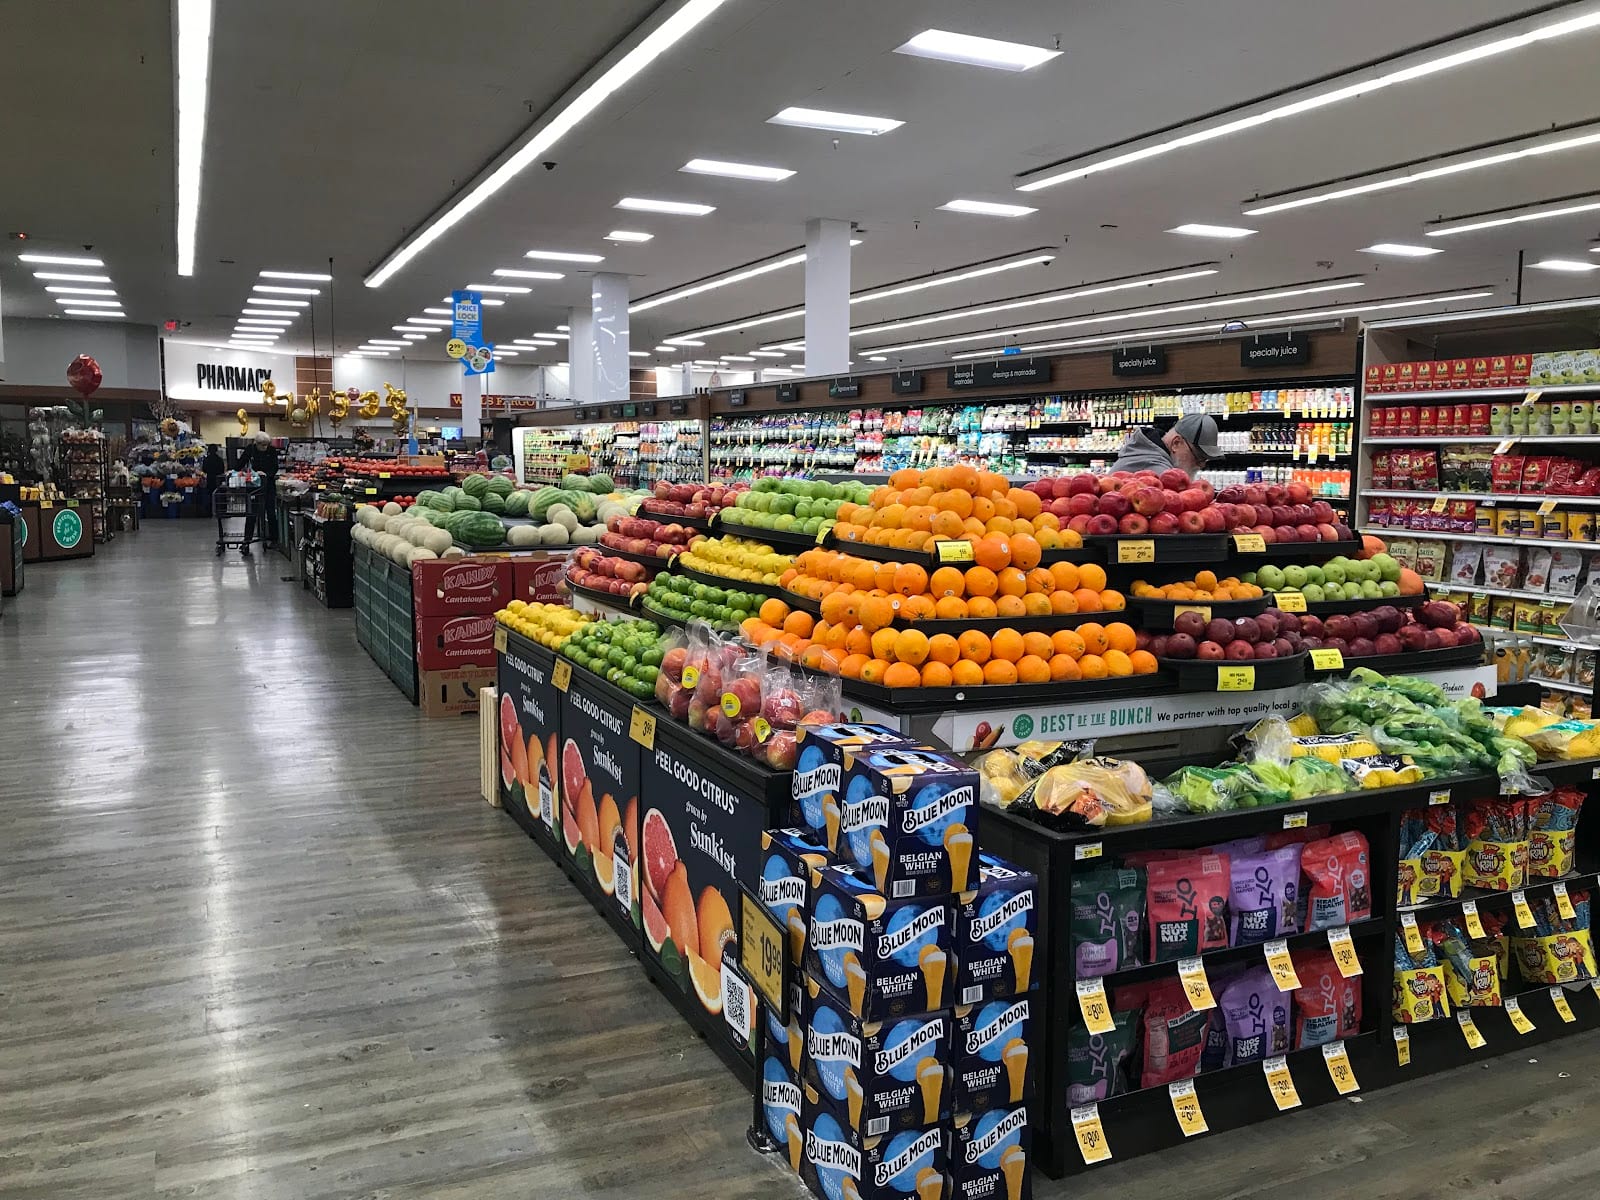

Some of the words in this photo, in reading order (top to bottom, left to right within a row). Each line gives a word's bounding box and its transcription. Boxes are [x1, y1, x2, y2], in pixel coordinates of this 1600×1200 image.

[457, 312, 477, 320] LOCK
[1249, 347, 1279, 358] specialty
[1279, 346, 1298, 357] juice
[1118, 358, 1143, 369] specialty
[1142, 357, 1157, 368] juice
[1575, 359, 1596, 370] RAISINS
[196, 363, 272, 393] PHARMACY
[452, 395, 494, 405] WLS
[443, 566, 497, 591] KANDY
[445, 596, 492, 604] Cantaloupes
[443, 618, 496, 644] KANDY
[445, 648, 492, 657] Cantaloupes
[514, 658, 527, 675] GOOD
[522, 694, 545, 726] Sunkist
[582, 696, 599, 720] GOOD
[1040, 714, 1075, 734] BEST
[1077, 715, 1087, 725] OF
[1090, 712, 1106, 724] THE
[1109, 706, 1153, 727] BUNCH
[1157, 712, 1171, 722] We
[1173, 710, 1205, 722] partner
[1207, 706, 1225, 718] with
[1227, 705, 1242, 717] top
[1243, 702, 1270, 716] quality
[1271, 699, 1290, 710] local
[593, 744, 623, 786] Sunkist
[655, 747, 673, 775] PEEL
[673, 760, 700, 792] GOOD
[792, 771, 813, 798] BLUE
[814, 767, 839, 790] MOON
[685, 800, 701, 819] grown
[700, 809, 708, 825] by
[841, 800, 861, 830] BLUE
[861, 800, 888, 822] MOON
[903, 806, 938, 831] BLUE
[938, 788, 973, 812] MOON
[689, 821, 737, 881] Sunkist
[899, 851, 943, 863] BELGIAN
[1478, 851, 1495, 860] Fruit
[904, 860, 938, 871] WHITE
[1480, 860, 1494, 871] Roll
[759, 878, 778, 902] BLUE
[779, 879, 804, 903] MOON
[1316, 900, 1345, 909] HEALTHY
[971, 911, 1001, 941] BLUE
[1002, 893, 1031, 920] MOON
[1243, 921, 1267, 929] MIX
[810, 918, 831, 947] BLUE
[833, 922, 862, 948] MOON
[878, 929, 911, 958] BLUE
[912, 909, 943, 934] MOON
[1162, 934, 1188, 943] MIX
[968, 955, 1007, 971] BELGIAN
[972, 965, 1003, 978] WHITE
[876, 972, 918, 986] BELGIAN
[881, 982, 913, 994] WHITE
[790, 987, 800, 1009] ON
[968, 1024, 998, 1053] BLUE
[999, 1004, 1028, 1033] MOON
[808, 1027, 830, 1056] BLUE
[831, 1035, 859, 1061] MOON
[868, 1036, 878, 1044] 12
[876, 1049, 909, 1074] BLUE
[910, 1022, 942, 1049] MOON
[1238, 1047, 1259, 1058] MIX
[962, 1066, 1001, 1082] BELGIAN
[966, 1075, 997, 1088] WHITE
[777, 1084, 801, 1110] MOON
[873, 1085, 915, 1102] BELGIAN
[878, 1095, 911, 1109] WHITE
[960, 1127, 969, 1135] 12
[967, 1142, 997, 1163] BLUE
[997, 1110, 1025, 1139] MOON
[807, 1132, 832, 1163] BLUE
[832, 1141, 859, 1173] MOON
[870, 1148, 878, 1156] 12
[876, 1157, 908, 1186] BLUE
[909, 1131, 939, 1159] MOON
[961, 1173, 1000, 1191] BELGIAN
[966, 1182, 995, 1197] WHITE
